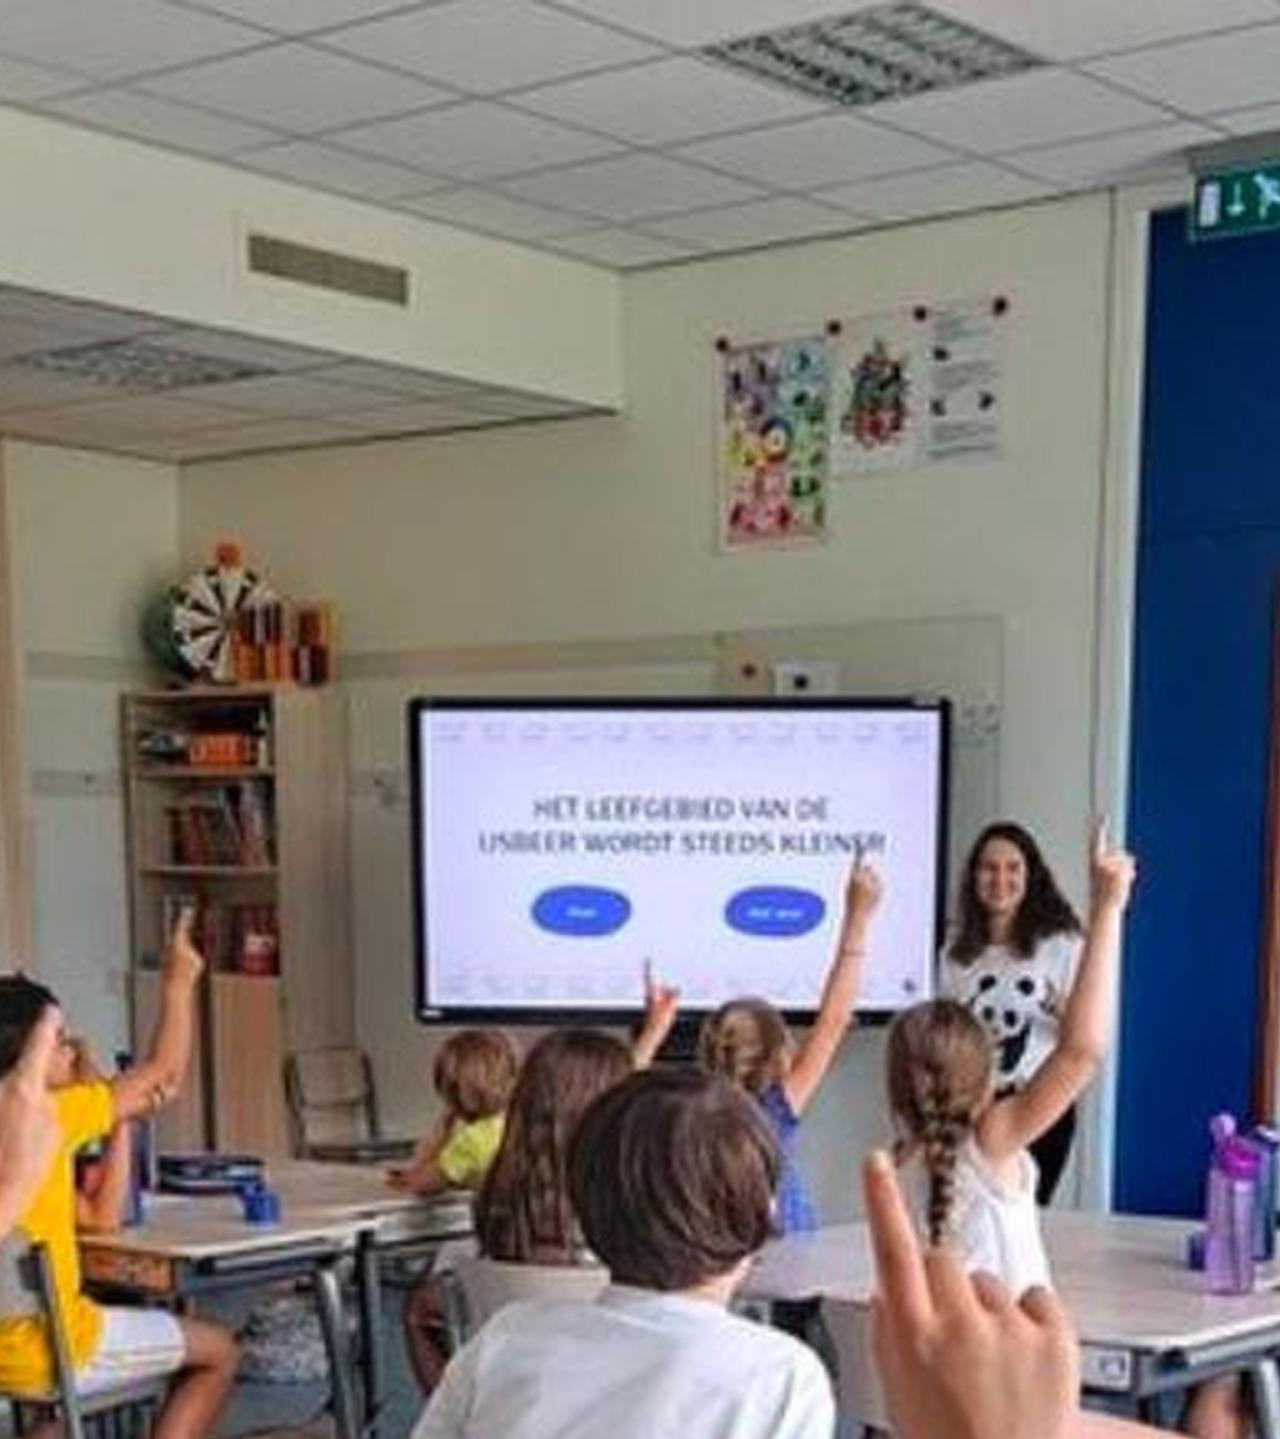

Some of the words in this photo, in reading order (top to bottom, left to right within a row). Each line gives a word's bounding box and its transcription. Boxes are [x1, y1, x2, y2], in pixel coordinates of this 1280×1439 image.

[534, 797, 577, 821] HET
[586, 797, 734, 821] LEEFGEBIED
[740, 797, 791, 821] VAN
[795, 797, 827, 821] DE
[584, 830, 674, 854] WORDT
[682, 830, 774, 854] STEEDS
